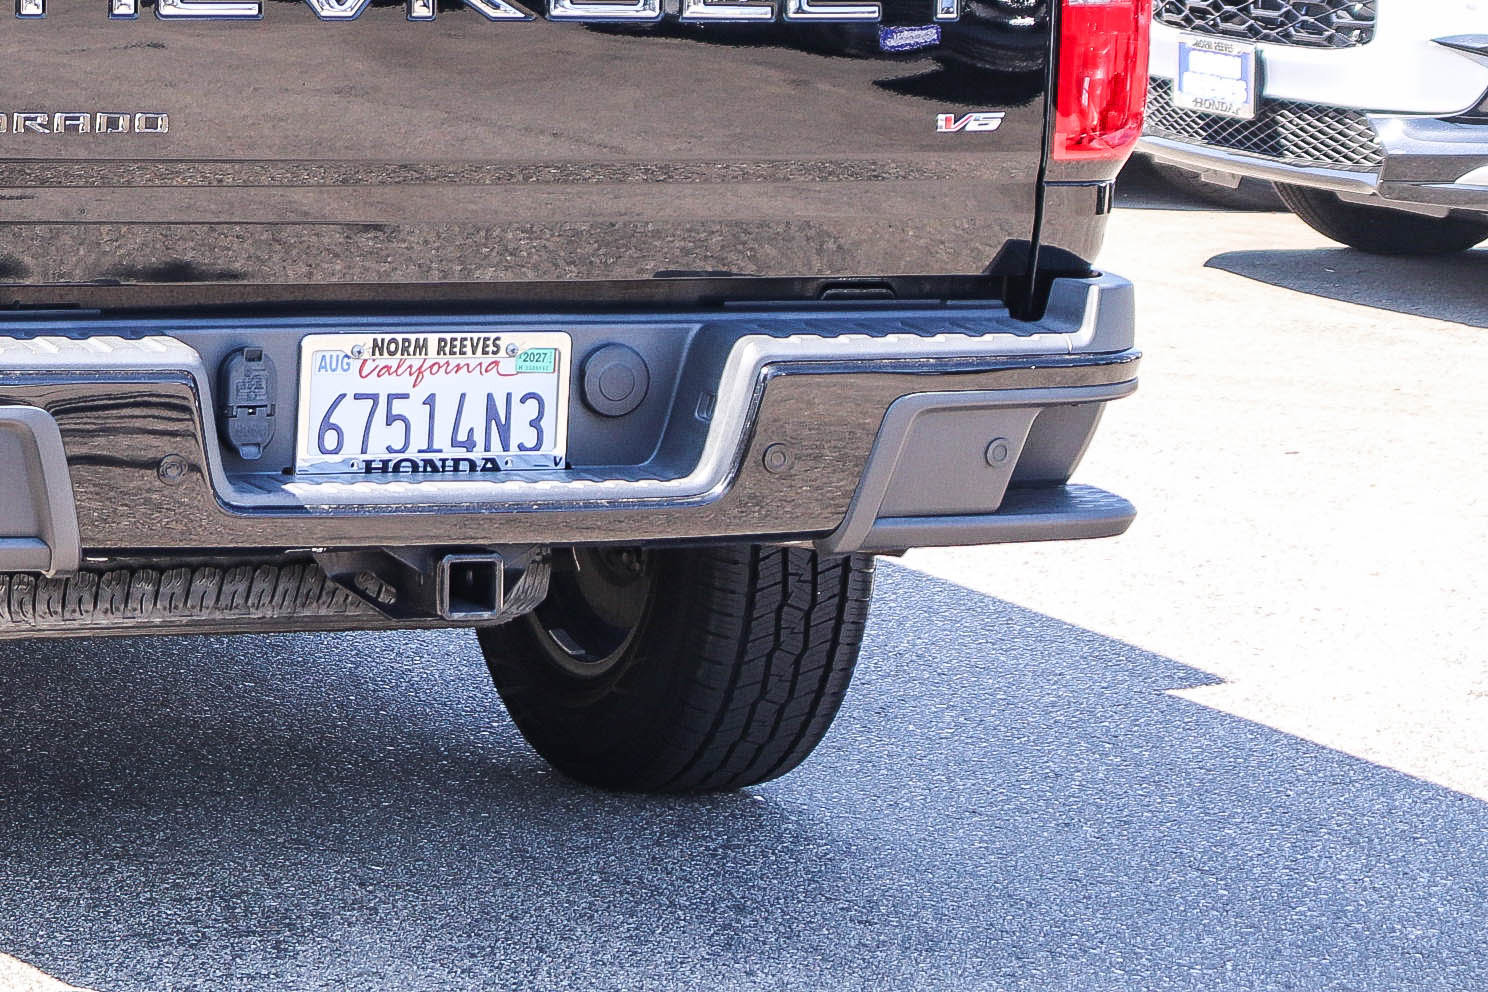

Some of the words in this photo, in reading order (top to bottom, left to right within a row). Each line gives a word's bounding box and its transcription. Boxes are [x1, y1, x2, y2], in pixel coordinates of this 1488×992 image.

[371, 337, 429, 357] NORM
[437, 336, 502, 357] REEVES
[318, 354, 352, 373] AUG
[522, 352, 548, 363] 2027
[358, 358, 518, 388] California
[317, 392, 546, 454] 67514N3
[363, 457, 502, 475] HONDA
